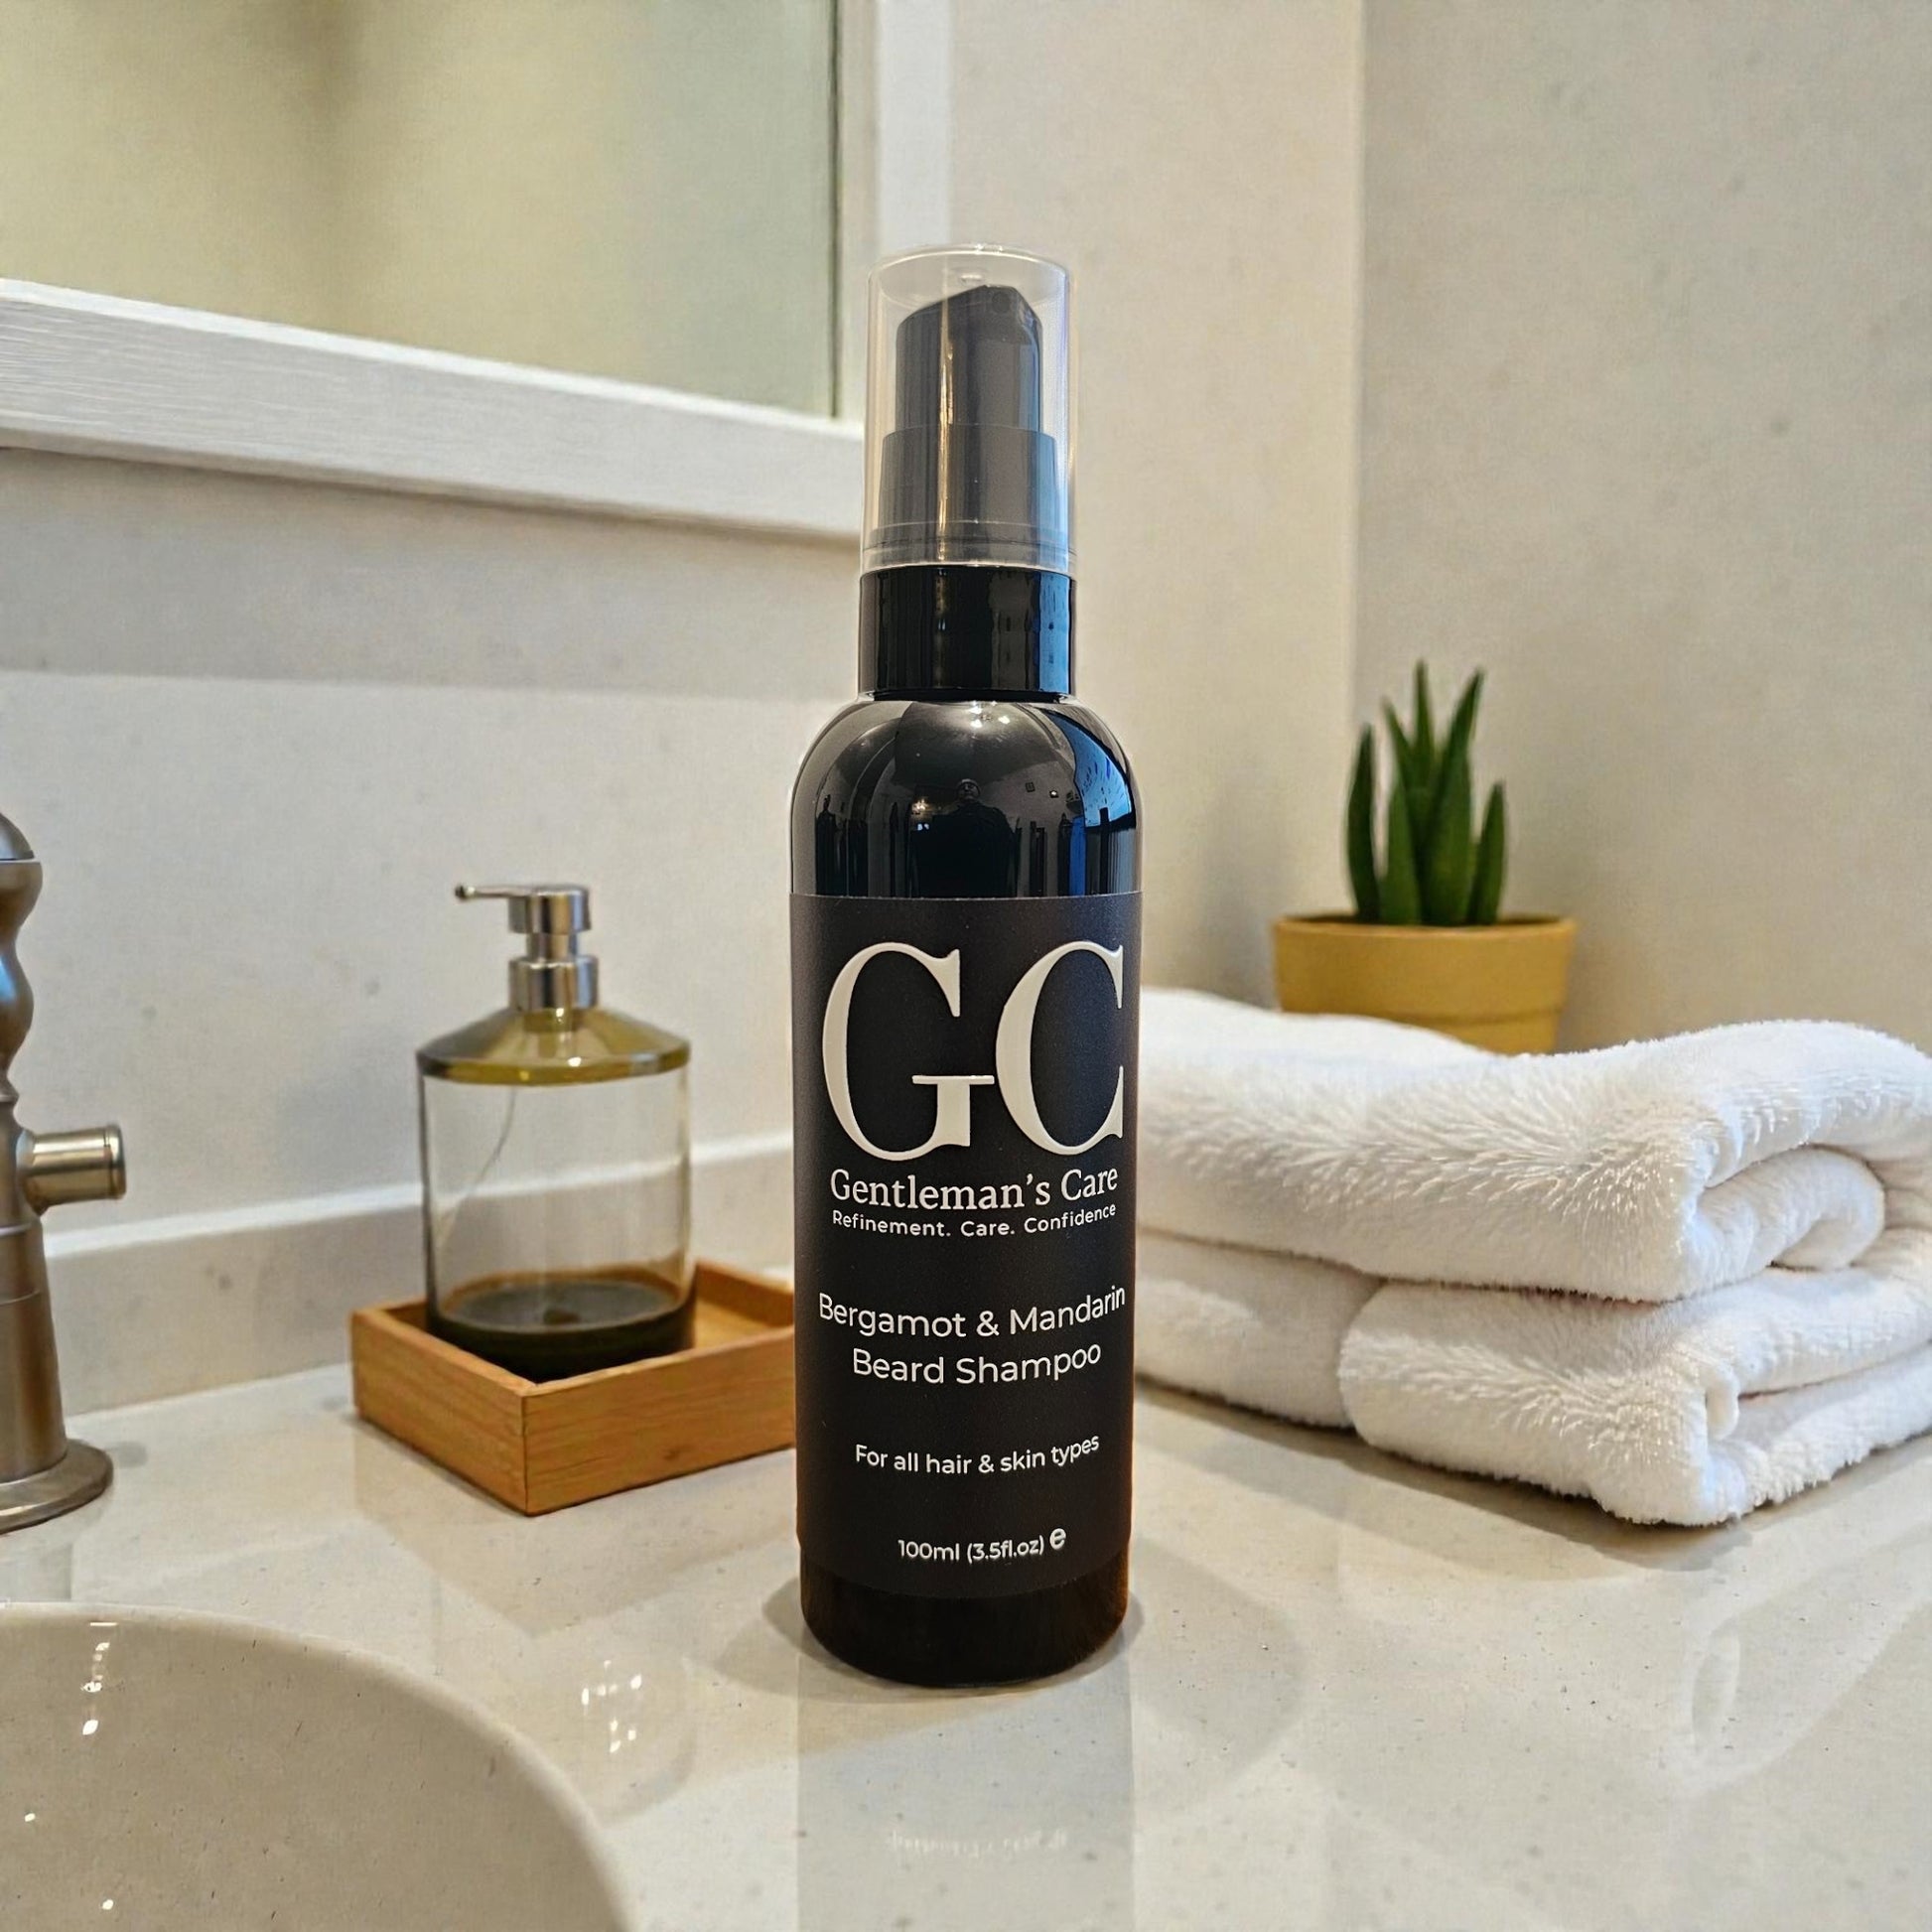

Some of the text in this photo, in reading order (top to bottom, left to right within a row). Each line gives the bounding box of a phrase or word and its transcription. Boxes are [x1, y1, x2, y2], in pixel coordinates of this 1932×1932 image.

[822, 940, 1125, 1162] GC
[830, 1168, 1119, 1210] Gentleman's Care
[832, 1203, 1117, 1237] Refinement. Care. Confidence
[819, 1285, 1126, 1337] Bergamot & Mandarin
[853, 1343, 1102, 1384] Beard Shampoo
[856, 1435, 1100, 1474] For all hair & skin types
[897, 1539, 960, 1561] 100ml
[966, 1535, 1044, 1565] (3.5fl.oz)
